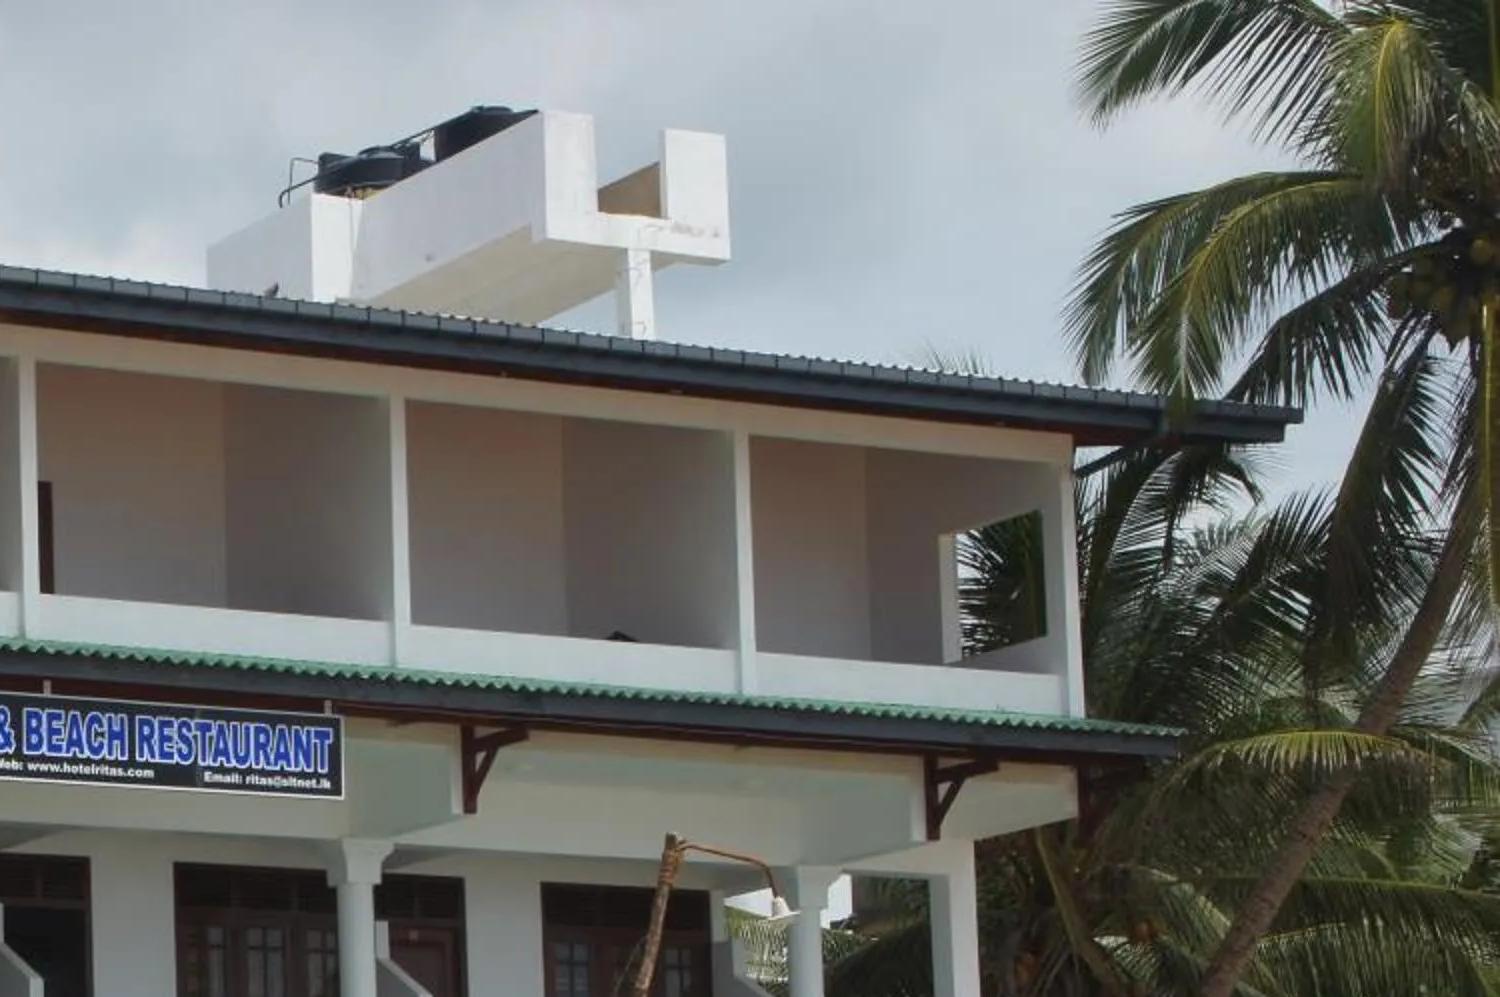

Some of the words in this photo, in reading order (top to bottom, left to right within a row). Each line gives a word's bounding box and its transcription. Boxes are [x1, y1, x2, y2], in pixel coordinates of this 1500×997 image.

[23, 707, 128, 760] BEACH
[136, 716, 333, 774] RESTAURANT
[27, 761, 155, 778] www.hotelritas.com
[203, 771, 243, 785] Email:
